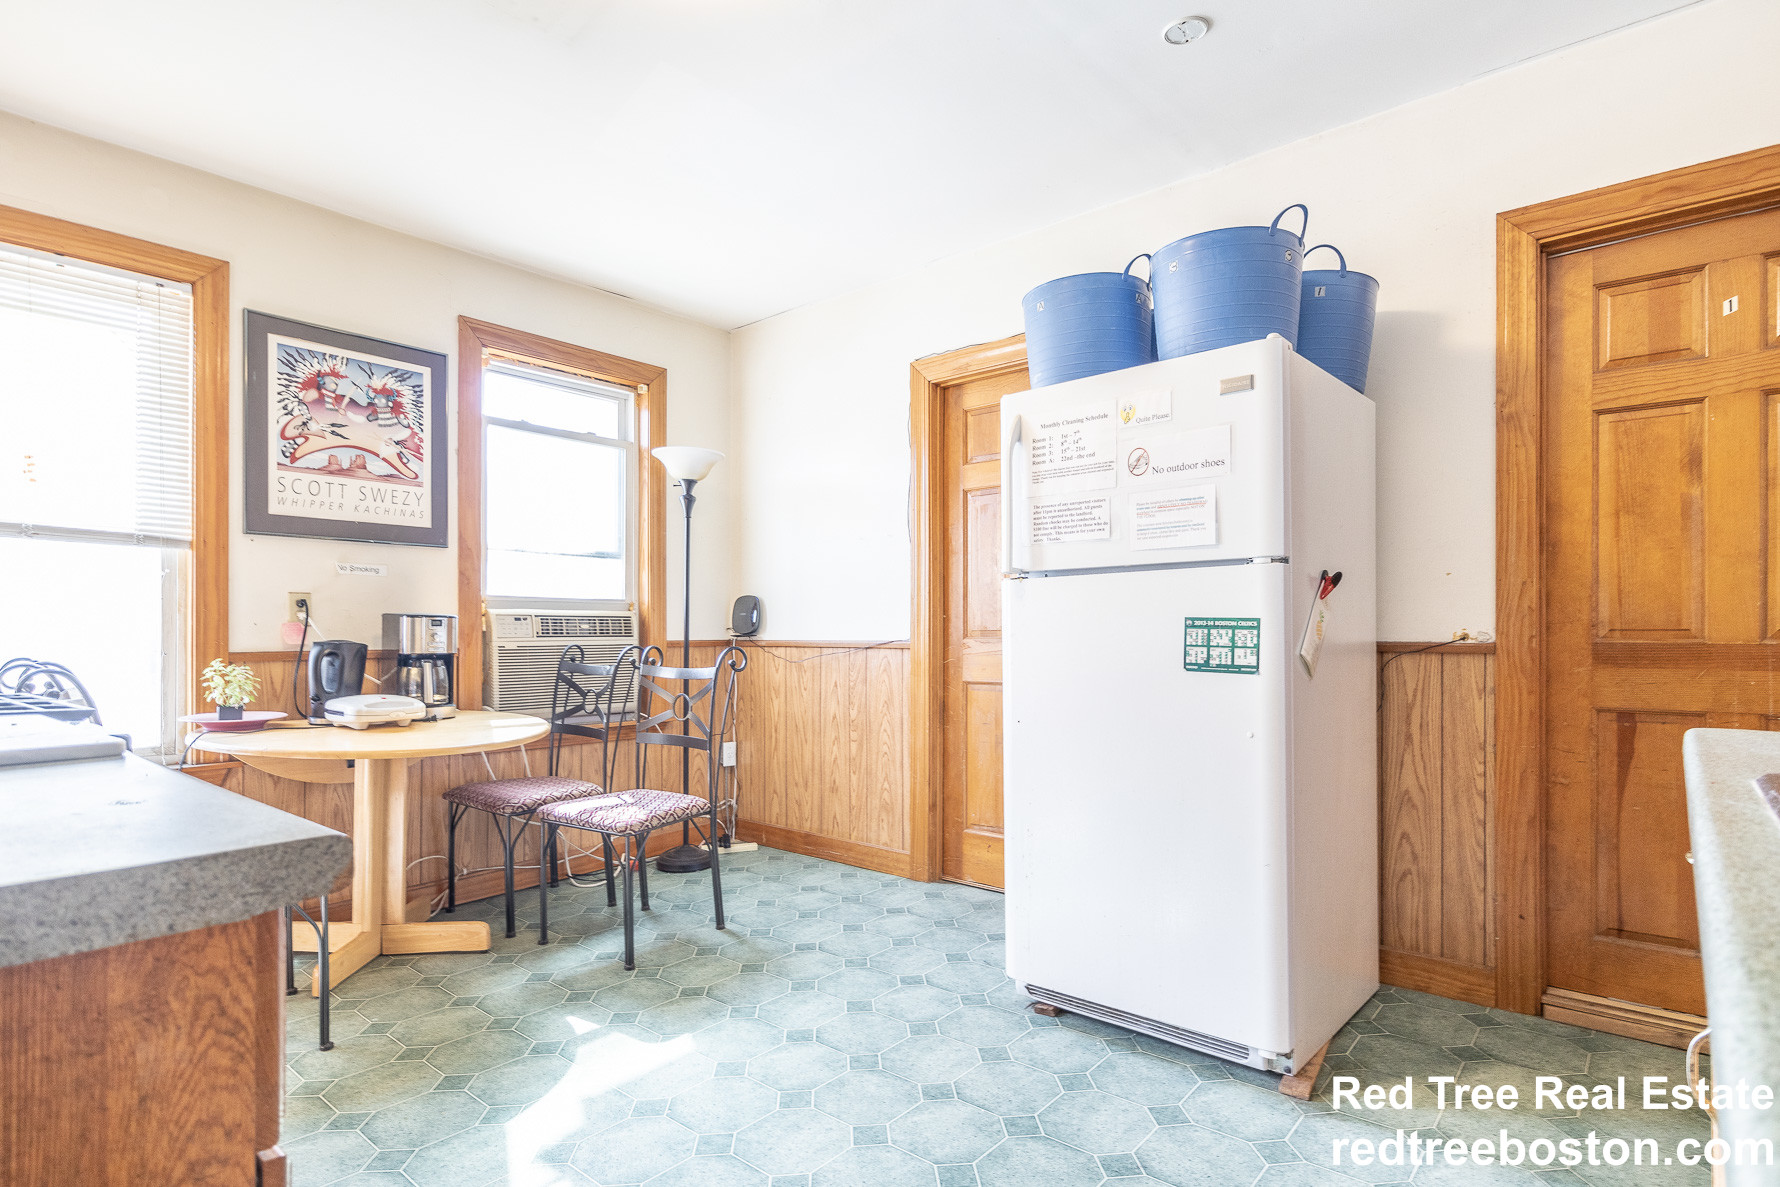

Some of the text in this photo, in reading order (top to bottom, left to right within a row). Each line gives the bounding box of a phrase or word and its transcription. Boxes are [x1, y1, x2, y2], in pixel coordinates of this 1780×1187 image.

[1038, 302, 1045, 312] A
[1062, 417, 1084, 426] Cleaning
[1085, 413, 1108, 422] Schedule
[1152, 459, 1226, 475] No outdoor shoes
[277, 476, 424, 507] SCOTT SWEZY
[277, 496, 425, 519] WHIPPER KACHINAS
[349, 564, 380, 574] Smoking
